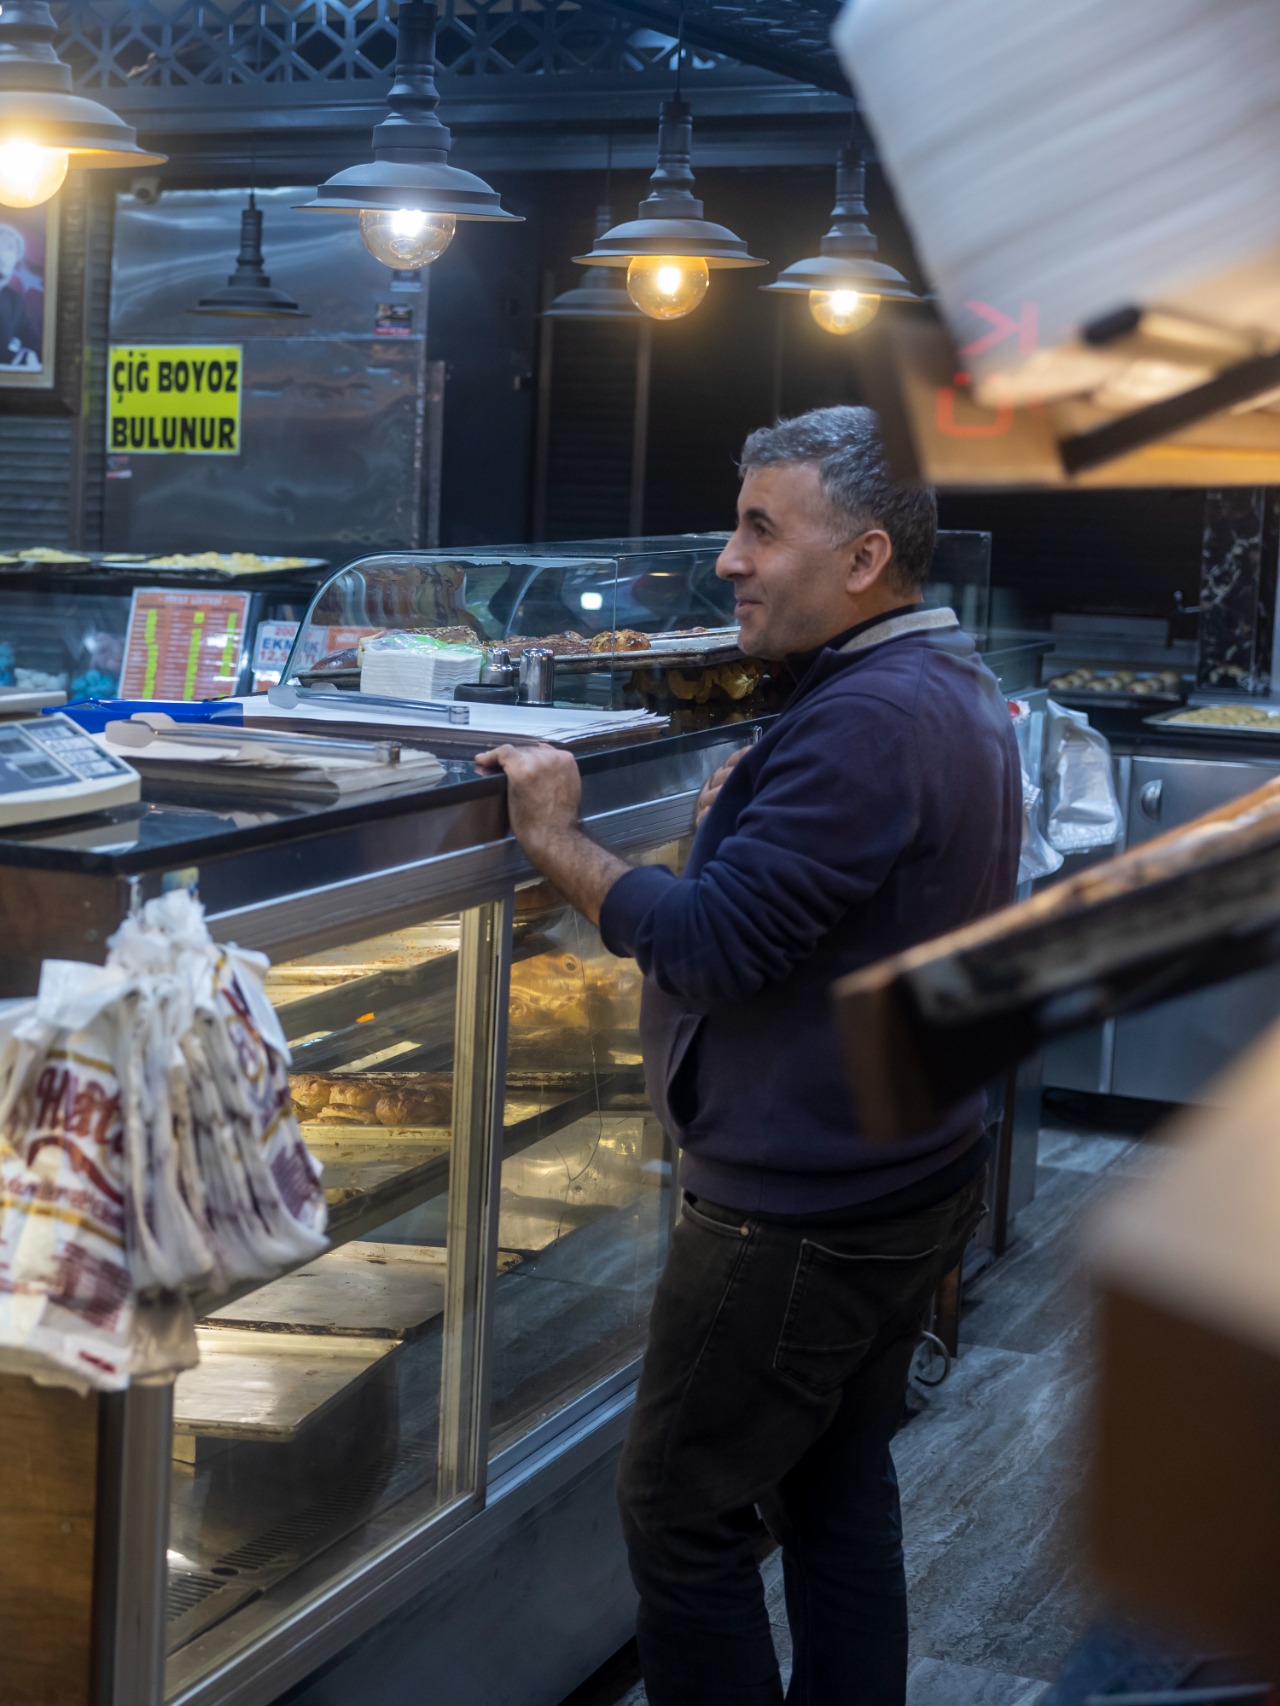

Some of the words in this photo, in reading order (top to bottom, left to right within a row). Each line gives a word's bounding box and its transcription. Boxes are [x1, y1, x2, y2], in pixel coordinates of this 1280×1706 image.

[112, 351, 150, 404] ÇİĞ
[158, 360, 238, 393] BOYOZ
[112, 417, 236, 449] BULUNUR
